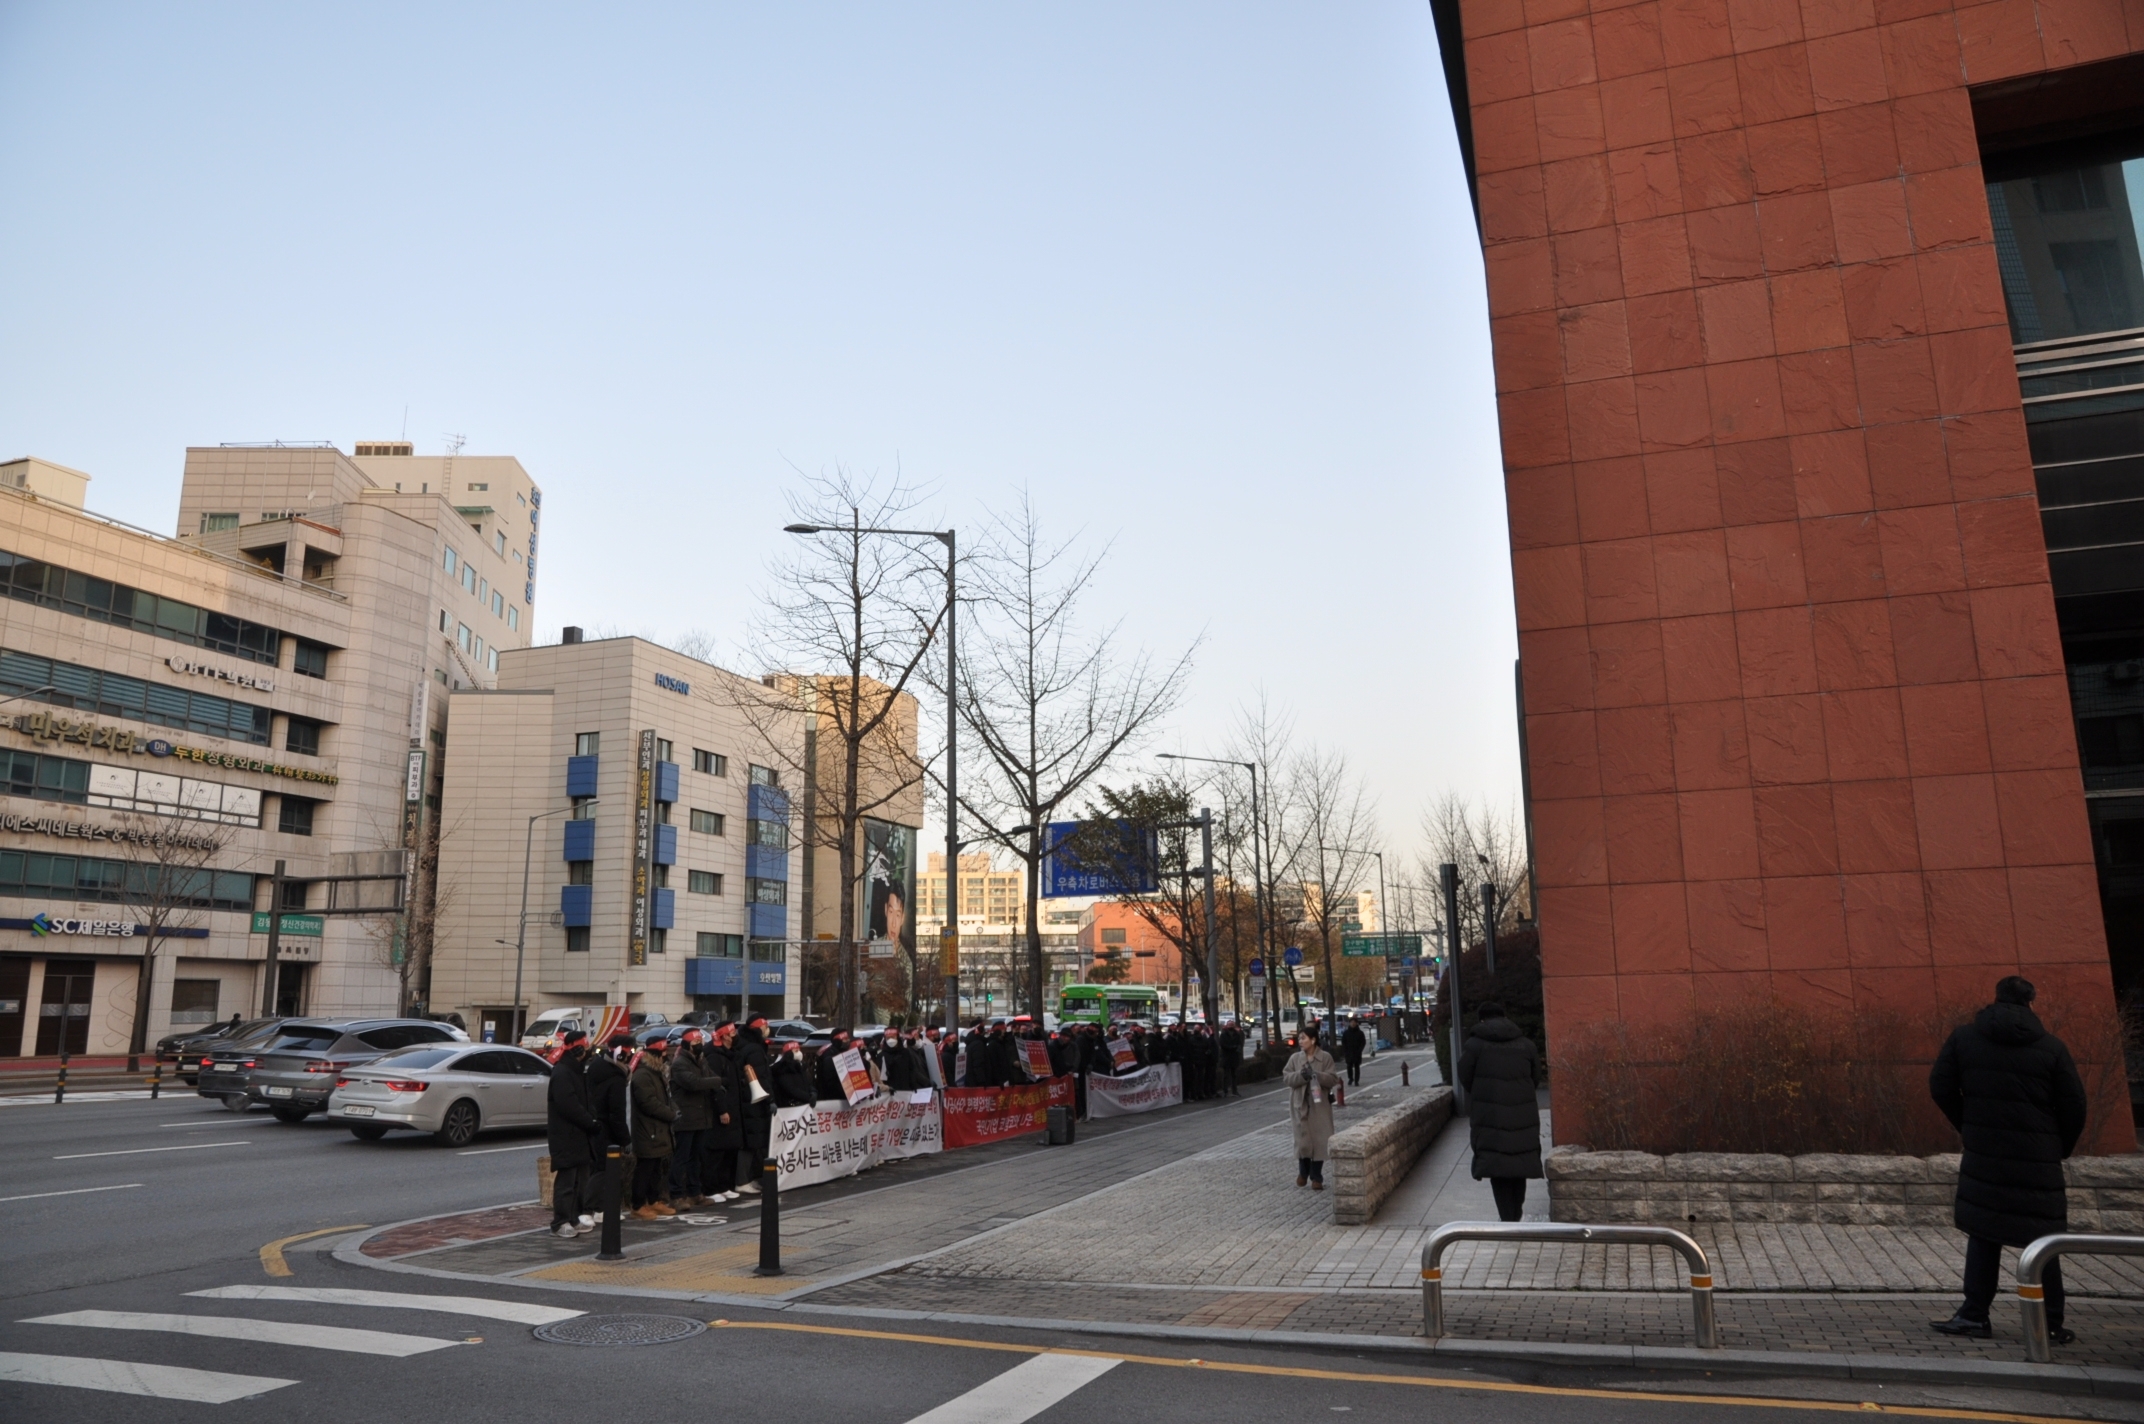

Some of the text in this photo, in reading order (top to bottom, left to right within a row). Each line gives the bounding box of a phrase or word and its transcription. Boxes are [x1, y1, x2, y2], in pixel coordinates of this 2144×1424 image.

[655, 672, 690, 696] HOSAN
[154, 742, 166, 751] DH
[174, 746, 266, 774] 두한성형외과
[642, 732, 652, 770] 산부인과
[639, 810, 648, 838] 피부과
[638, 840, 647, 860] 내과
[636, 866, 646, 896] 소아과
[50, 918, 135, 938] SC제일은행
[635, 898, 645, 938] 여성외과
[778, 1114, 818, 1142] 시공사는
[843, 1136, 868, 1160] 나는데
